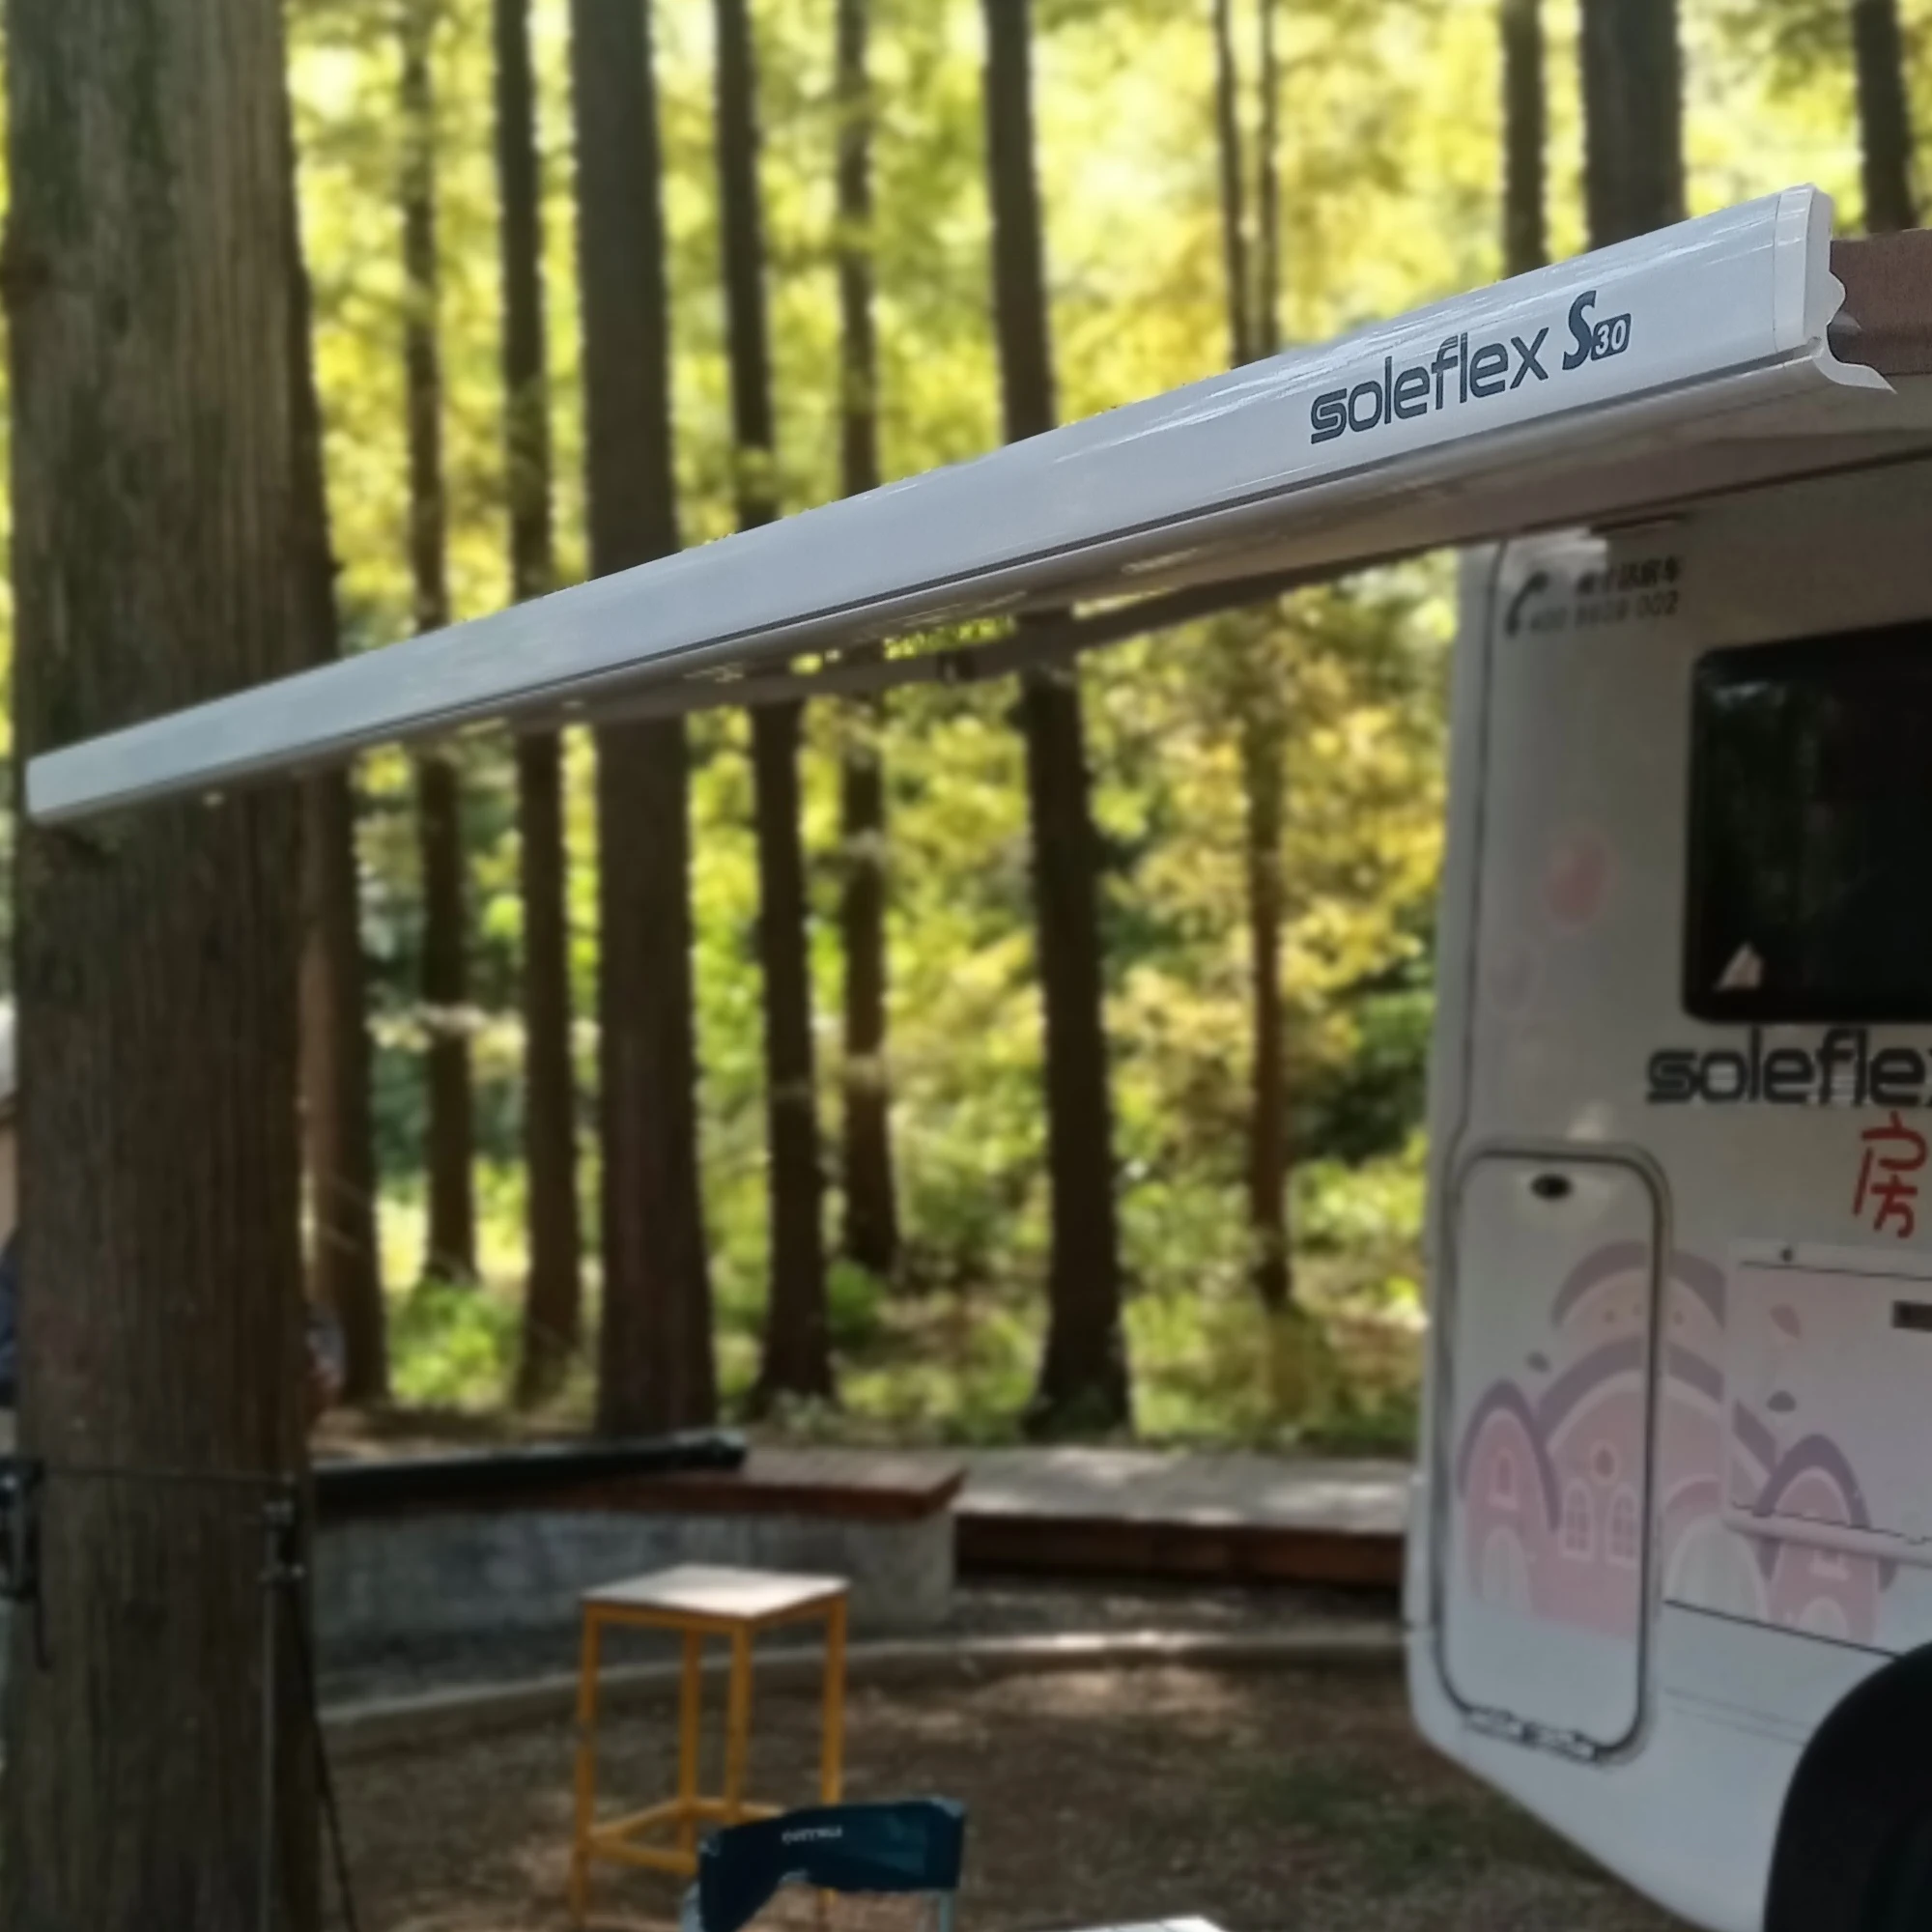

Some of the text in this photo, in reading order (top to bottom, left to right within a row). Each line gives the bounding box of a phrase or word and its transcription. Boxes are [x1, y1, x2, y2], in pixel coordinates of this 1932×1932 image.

[1311, 327, 1549, 444] soleflex
[1647, 1025, 1932, 1107] solefle
[1853, 1111, 1928, 1239] 房
